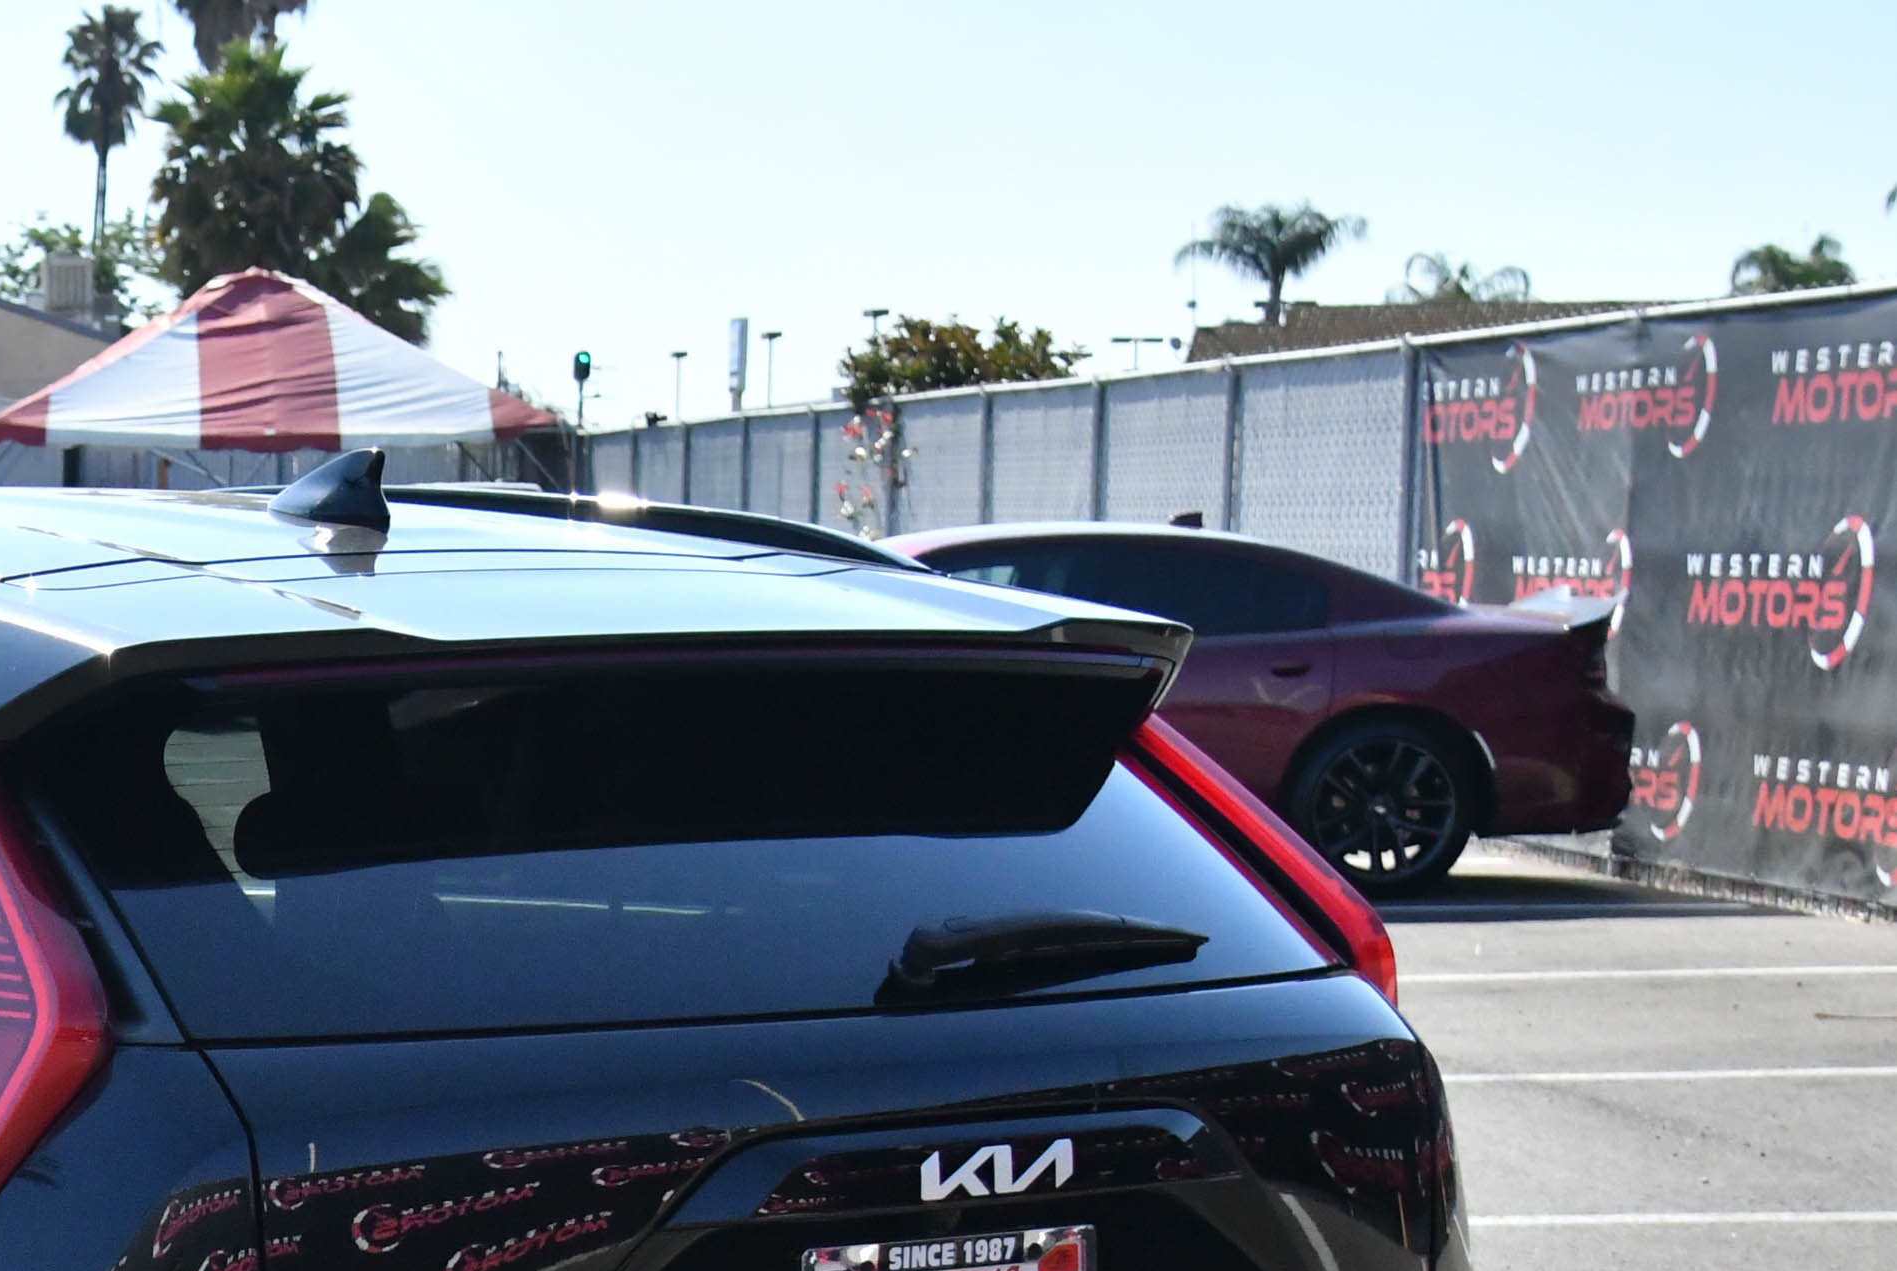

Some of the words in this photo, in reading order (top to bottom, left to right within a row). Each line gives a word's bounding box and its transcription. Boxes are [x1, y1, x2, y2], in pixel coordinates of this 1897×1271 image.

[1576, 366, 1677, 393] WESTERN
[1577, 386, 1695, 432] MOTORS
[1512, 555, 1602, 577] WESTERN
[1687, 553, 1823, 578] WESTERN
[1687, 579, 1847, 629] MOTORS
[1754, 754, 1889, 792] WESTERN
[921, 1138, 1073, 1200] KIA
[888, 1242, 955, 1271] SINCE
[963, 1237, 1017, 1264] 1987
